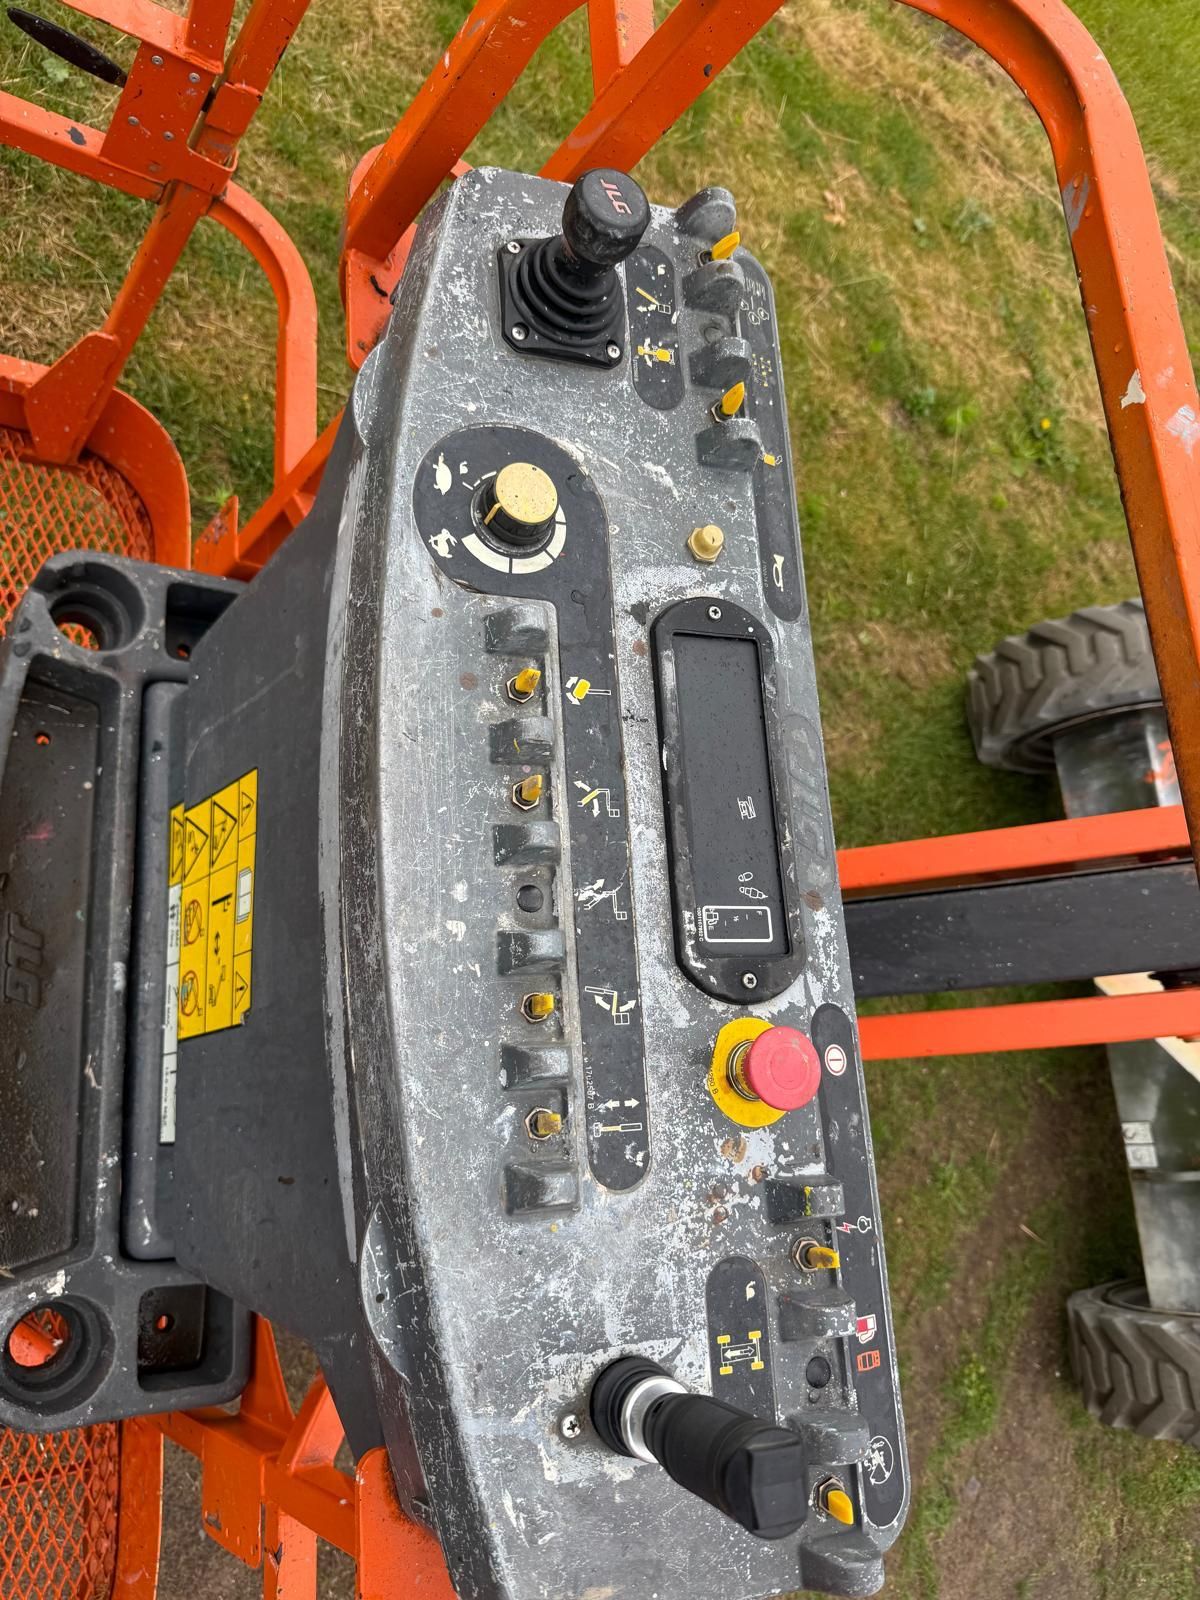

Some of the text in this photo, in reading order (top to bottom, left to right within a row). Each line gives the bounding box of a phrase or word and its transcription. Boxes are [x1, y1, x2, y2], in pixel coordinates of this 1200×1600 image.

[600, 178, 633, 215] JLG
[4, 911, 44, 1009] JLG
[587, 1102, 595, 1110] B
